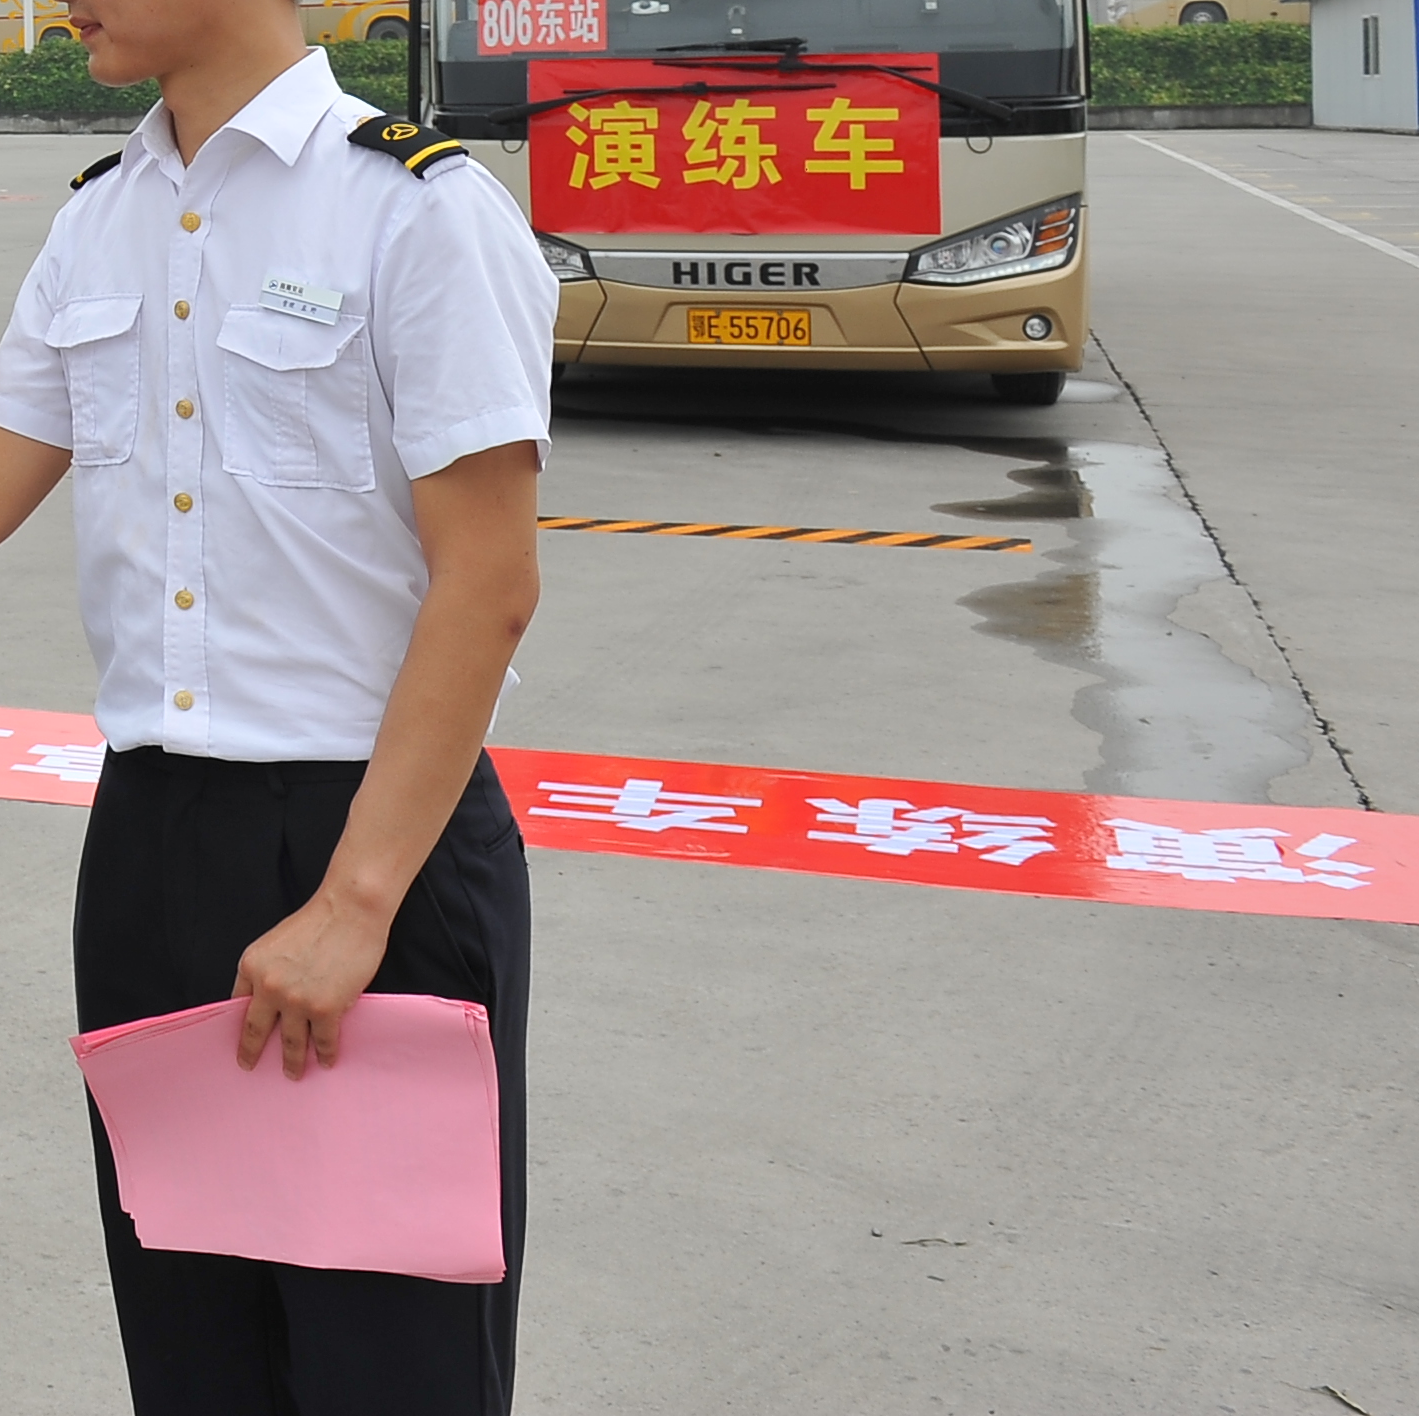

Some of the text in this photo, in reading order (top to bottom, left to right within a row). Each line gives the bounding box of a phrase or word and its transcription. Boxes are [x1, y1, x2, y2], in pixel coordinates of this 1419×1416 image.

[565, 97, 904, 190] 演练车
[672, 261, 821, 286] HIGER
